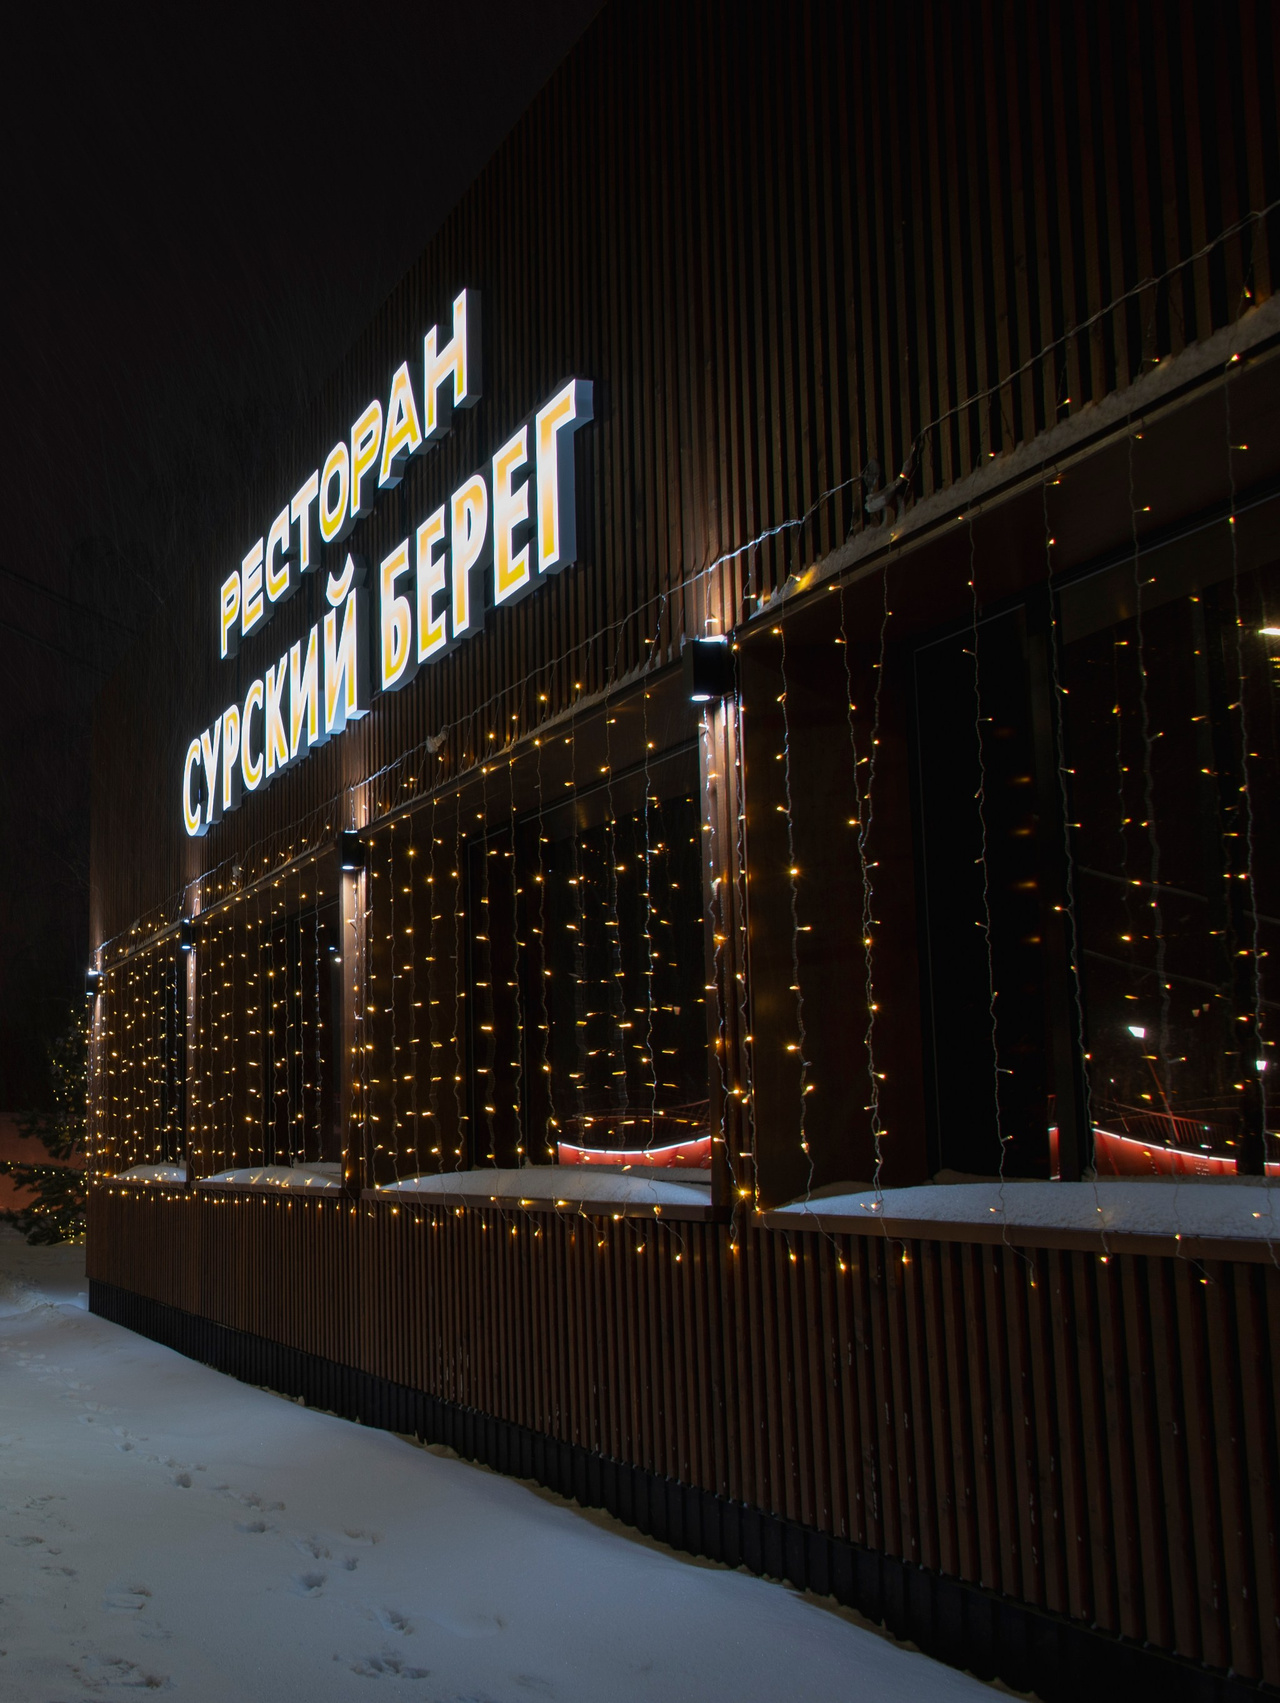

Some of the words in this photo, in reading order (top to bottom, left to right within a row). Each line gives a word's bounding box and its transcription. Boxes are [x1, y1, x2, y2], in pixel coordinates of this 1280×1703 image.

[182, 554, 361, 837] СУРСКИЙ
[380, 378, 581, 691] БЕРЕГ
[220, 288, 470, 659] РЕСТОРАН
